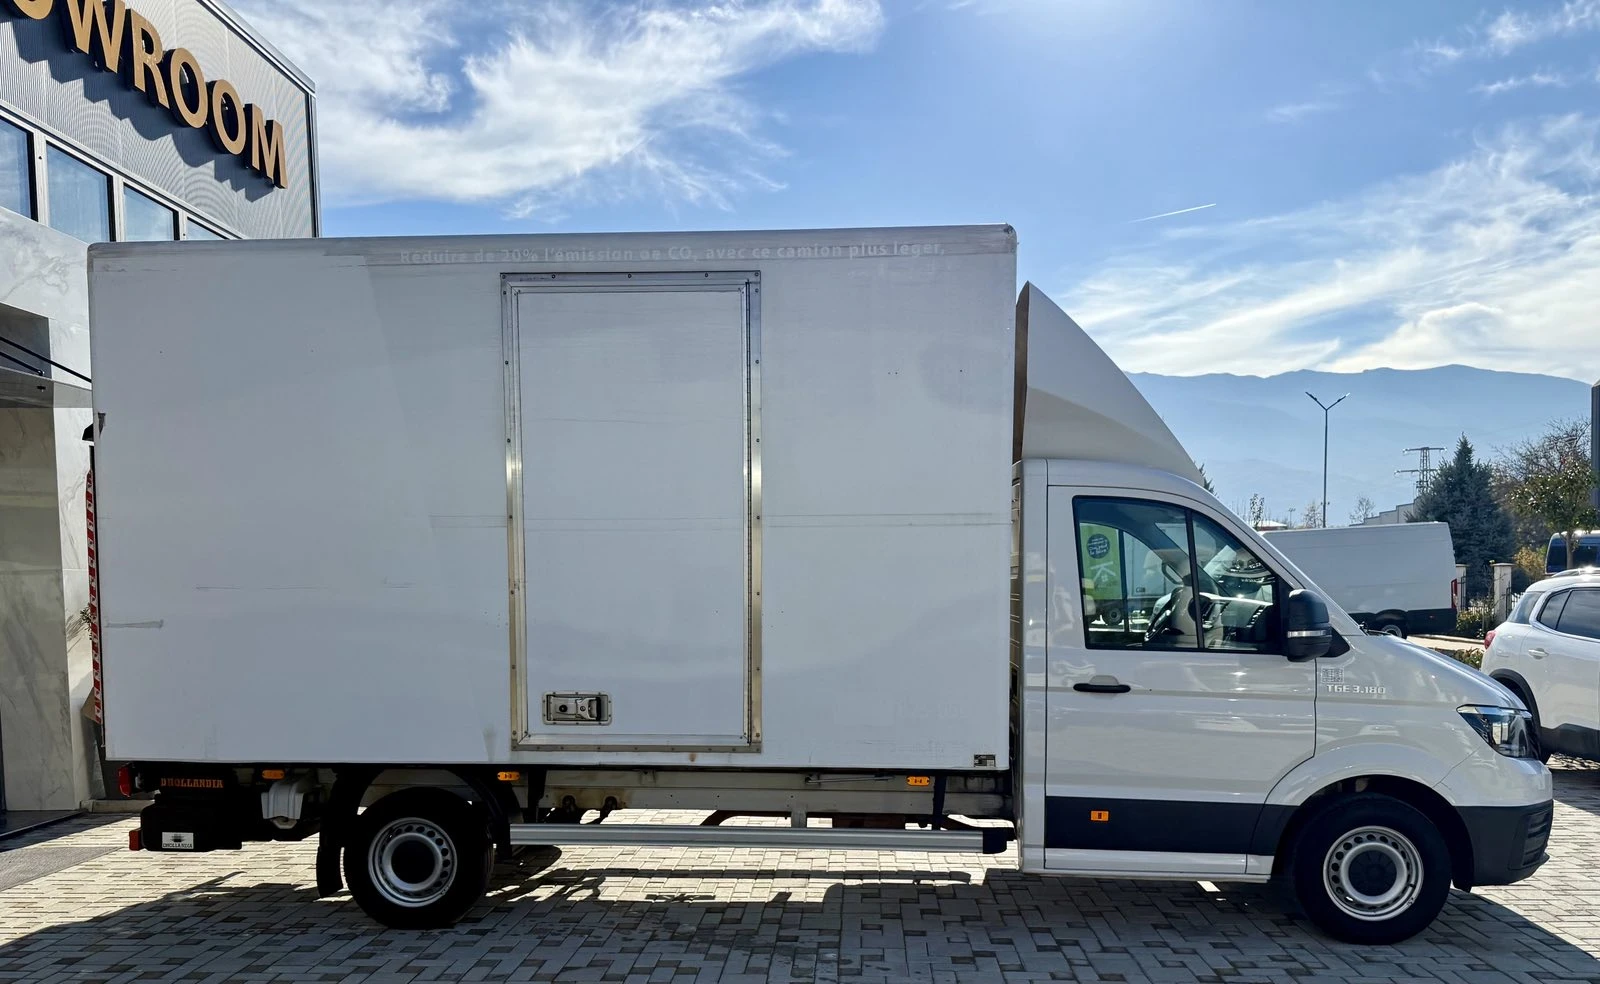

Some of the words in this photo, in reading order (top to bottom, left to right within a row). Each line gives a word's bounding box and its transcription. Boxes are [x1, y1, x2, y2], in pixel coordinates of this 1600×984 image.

[2, 0, 287, 189] WROOM
[474, 249, 496, 262] de
[705, 247, 746, 260] avec
[752, 247, 770, 259] ce
[776, 243, 842, 259] camion
[849, 242, 888, 260] plus
[1327, 684, 1350, 693] TGE
[1352, 685, 1387, 694] 3.180
[160, 777, 223, 788] DHOLLANDIA
